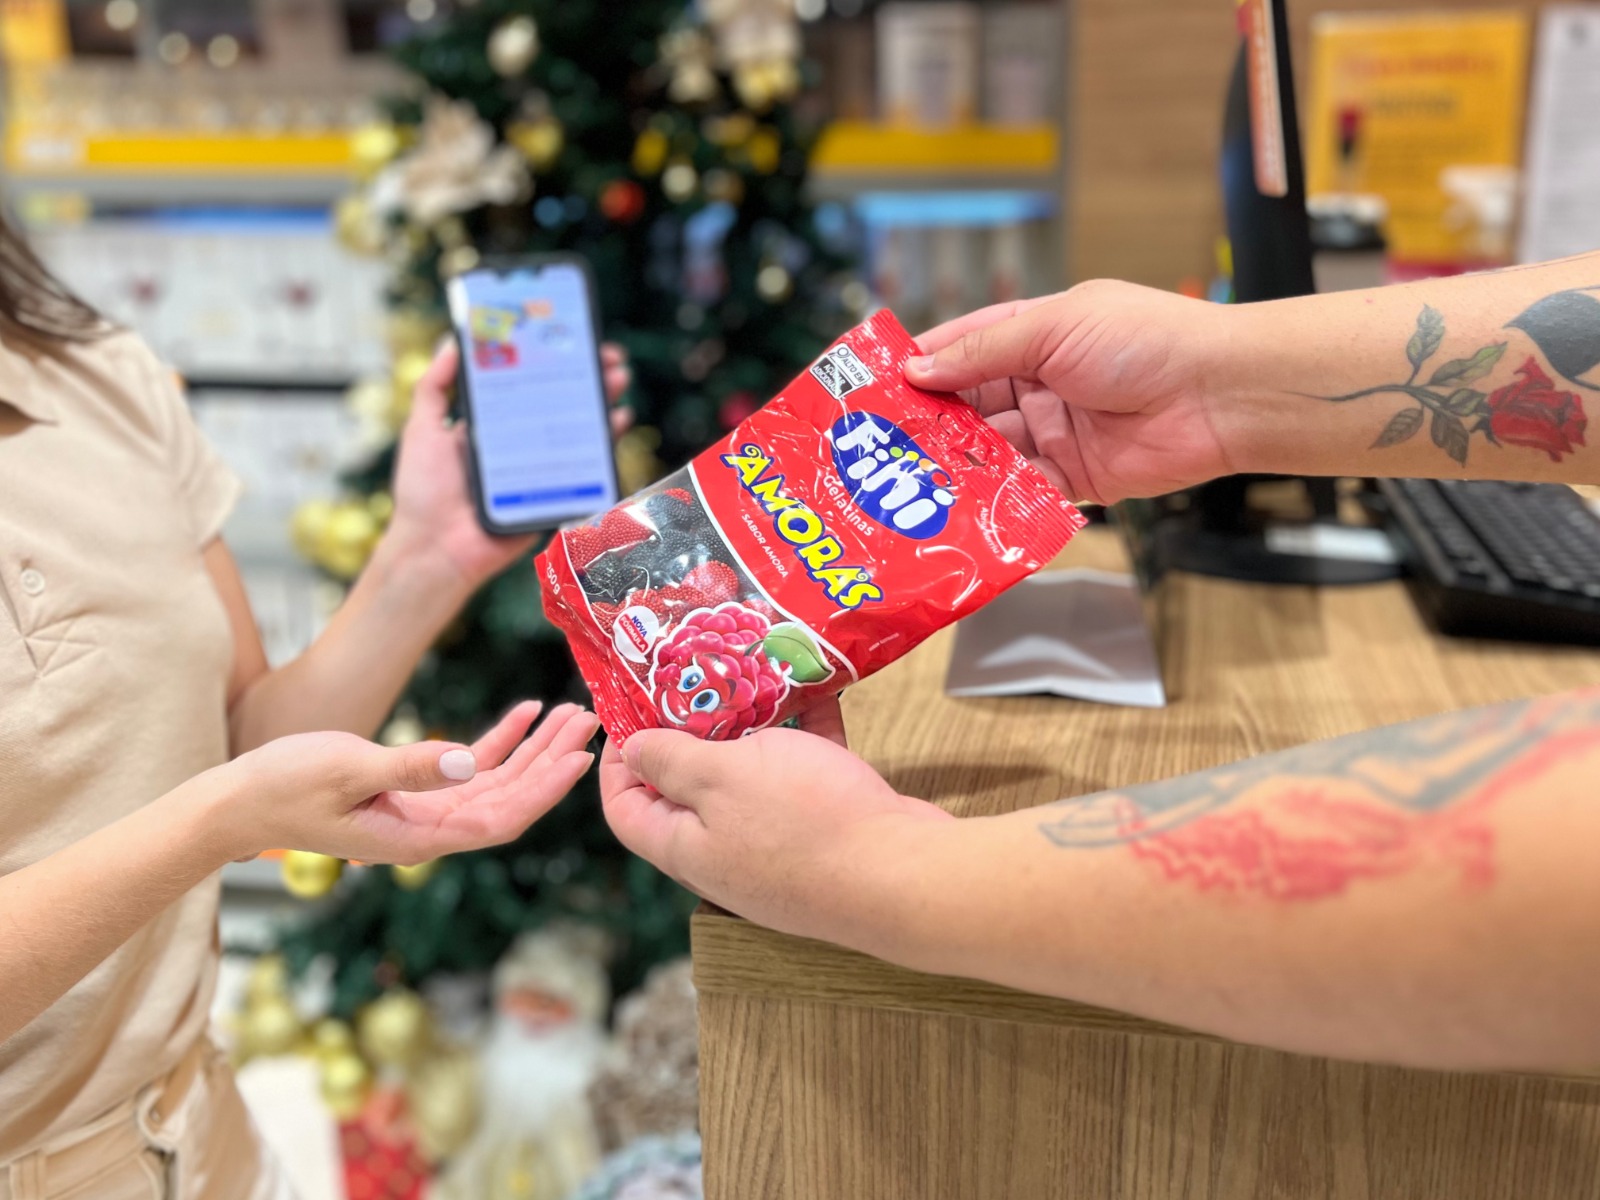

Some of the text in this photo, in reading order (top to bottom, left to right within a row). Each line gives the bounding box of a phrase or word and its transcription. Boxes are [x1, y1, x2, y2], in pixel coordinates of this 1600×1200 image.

[841, 358, 866, 383] ALTO EM
[721, 443, 883, 609] AMORAS
[822, 475, 876, 537] Gelatinas
[741, 513, 789, 578] SABOR AMORA
[631, 615, 648, 638] NOVA
